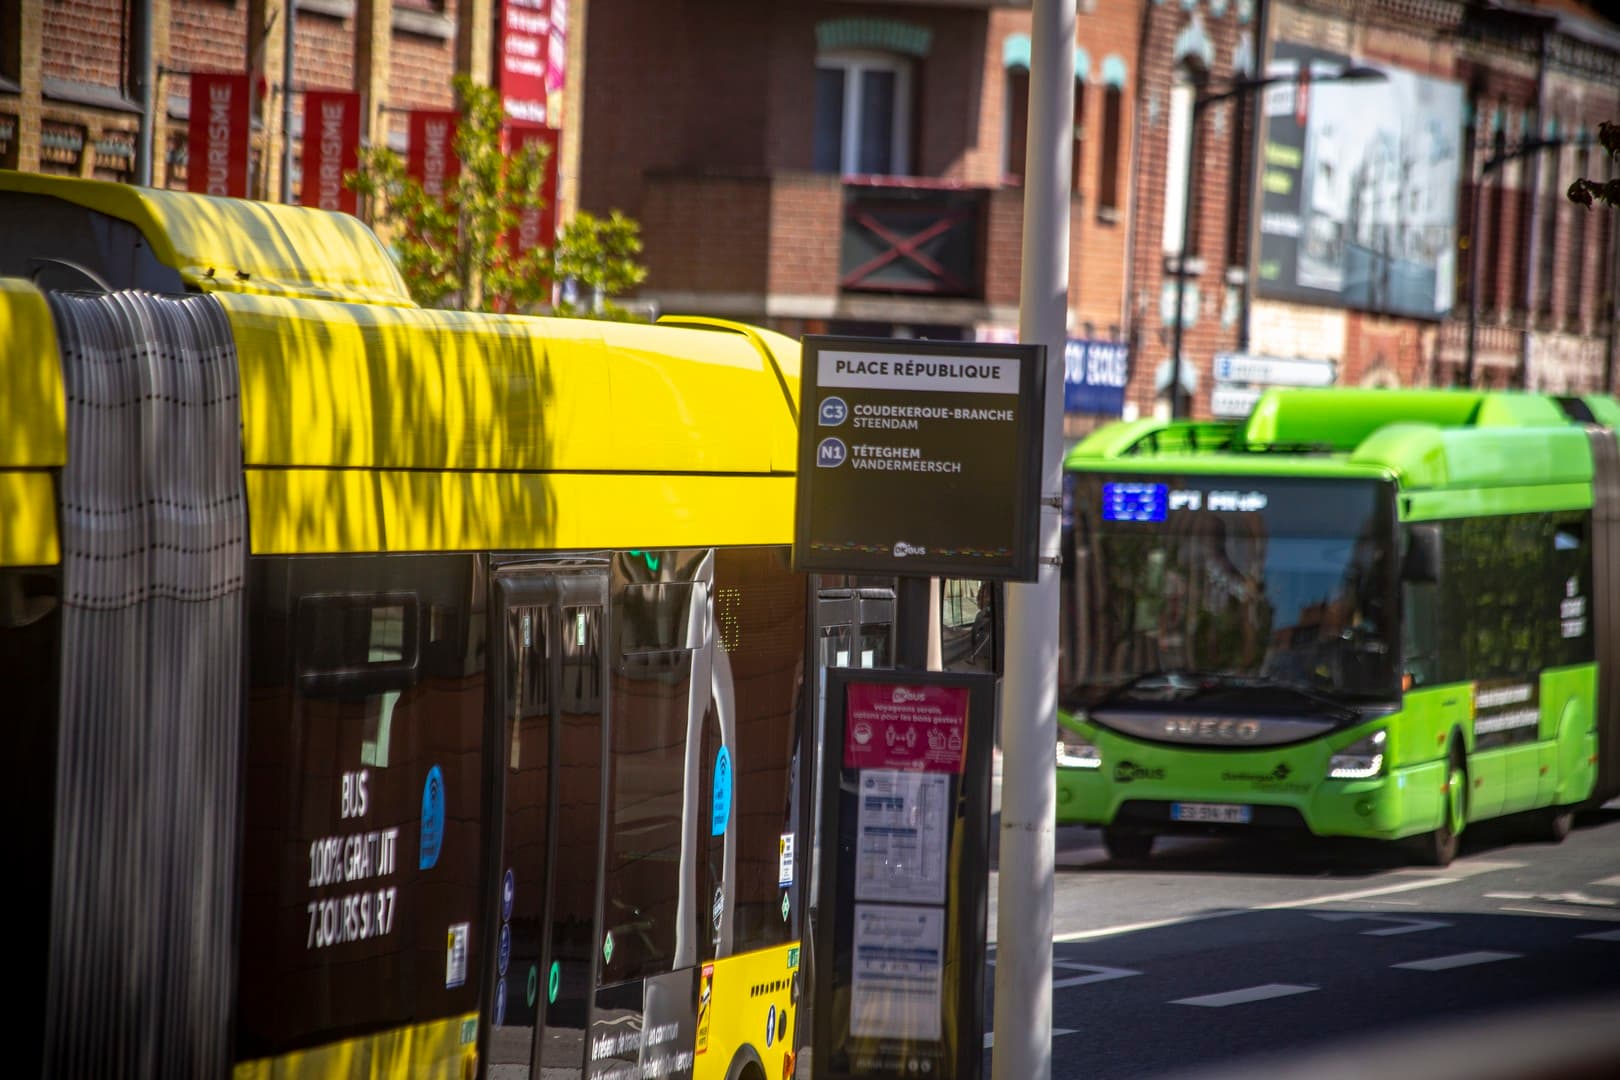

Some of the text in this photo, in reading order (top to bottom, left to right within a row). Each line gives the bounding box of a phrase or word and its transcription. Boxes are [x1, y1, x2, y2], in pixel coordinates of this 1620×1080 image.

[207, 83, 232, 196] OURISME
[836, 360, 1001, 380] PLACE RÉPUBLIQUE
[822, 405, 1014, 421] C3 COUDEKERQUE-BRANCHE
[853, 418, 918, 430] STEENDAM
[821, 444, 920, 460] N1 TÉTEGHEM
[852, 459, 961, 473] VANDERMEERSCH
[341, 769, 368, 819] BUS
[308, 836, 344, 888] 100%
[344, 826, 399, 882] GRATUIT
[307, 900, 318, 949] 7
[316, 892, 360, 949] JOURS
[385, 885, 397, 935] 7
